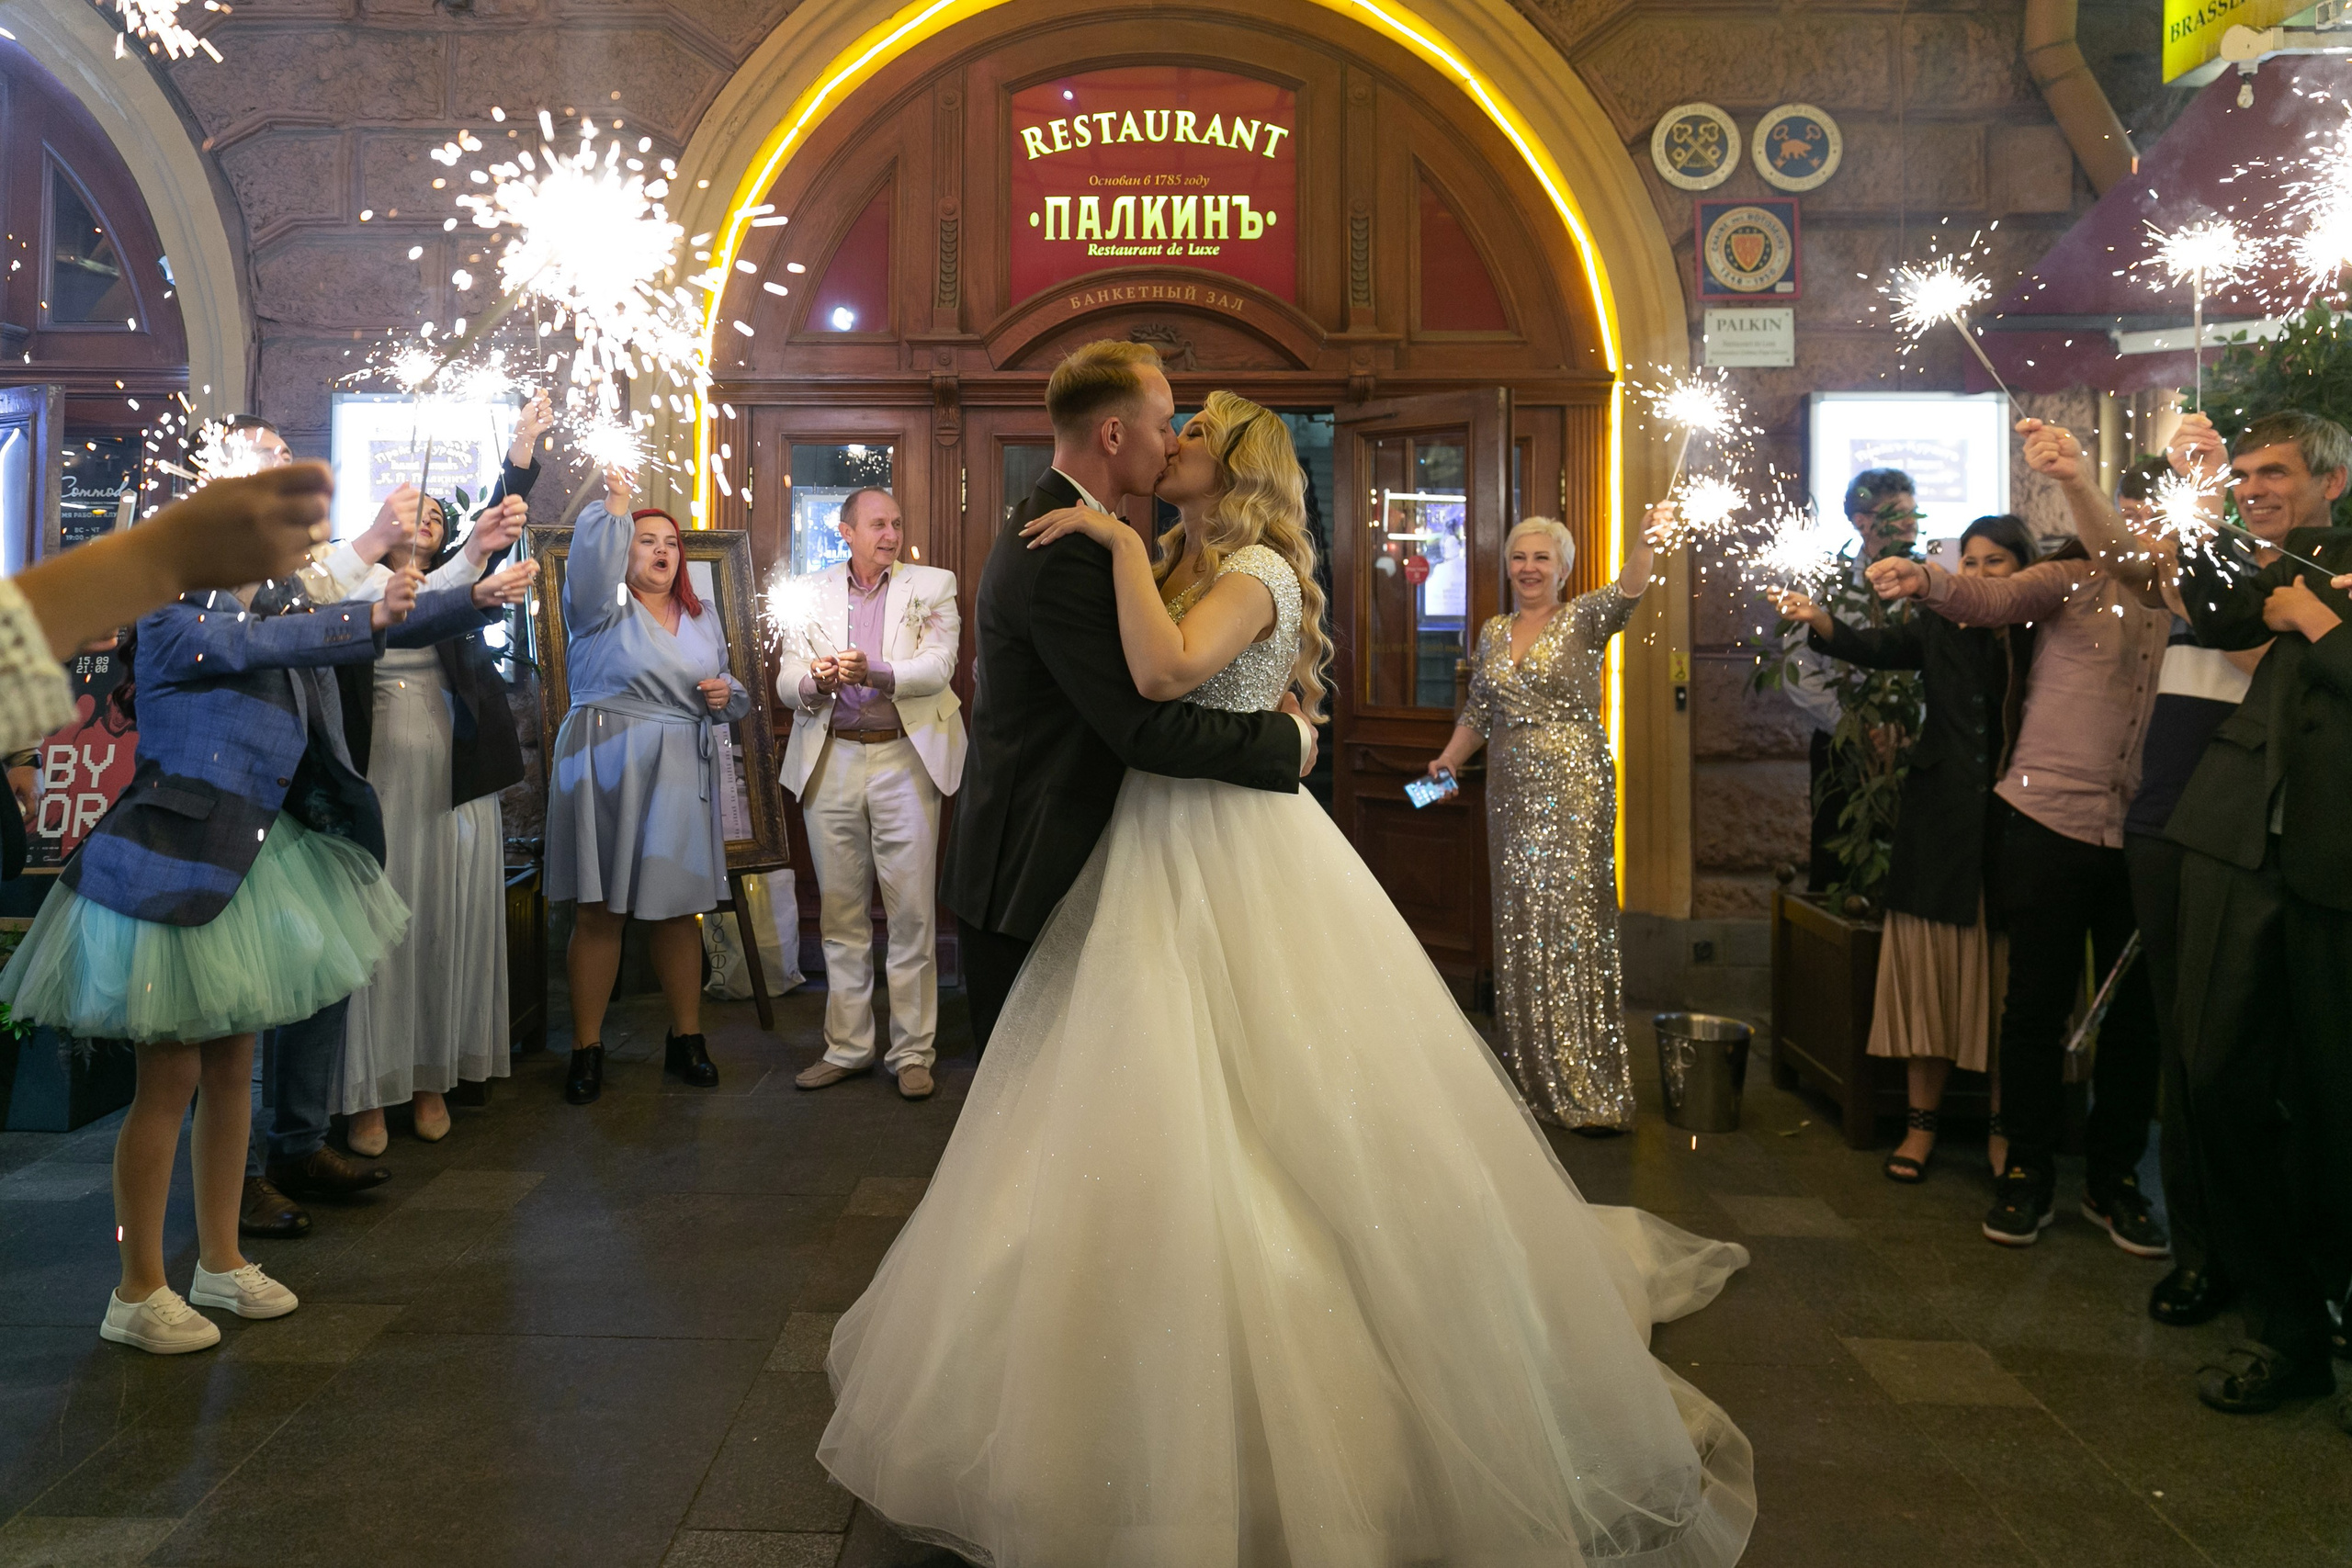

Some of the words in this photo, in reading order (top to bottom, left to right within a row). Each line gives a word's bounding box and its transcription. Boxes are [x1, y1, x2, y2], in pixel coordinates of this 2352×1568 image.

[2170, 0, 2247, 42] BRASS
[1020, 109, 1289, 160] RESTAURANT
[1089, 175, 1141, 186] Основан
[1143, 174, 1150, 186] в
[1154, 174, 1182, 186] 1785
[1183, 175, 1210, 188] году
[1044, 195, 1264, 241] ПАЛКИНЪ
[1088, 243, 1162, 256] Restaurant
[1167, 243, 1183, 256] de
[1187, 243, 1220, 256] Luxe
[1069, 285, 1197, 310] БАНКЕТНЫЙ
[1206, 291, 1244, 312] ЗАЛ
[1716, 318, 1782, 332] PALKIN
[61, 475, 130, 499] Commod
[76, 664, 108, 674] 21:00
[78, 656, 109, 665] 15.09
[44, 744, 116, 789] BY
